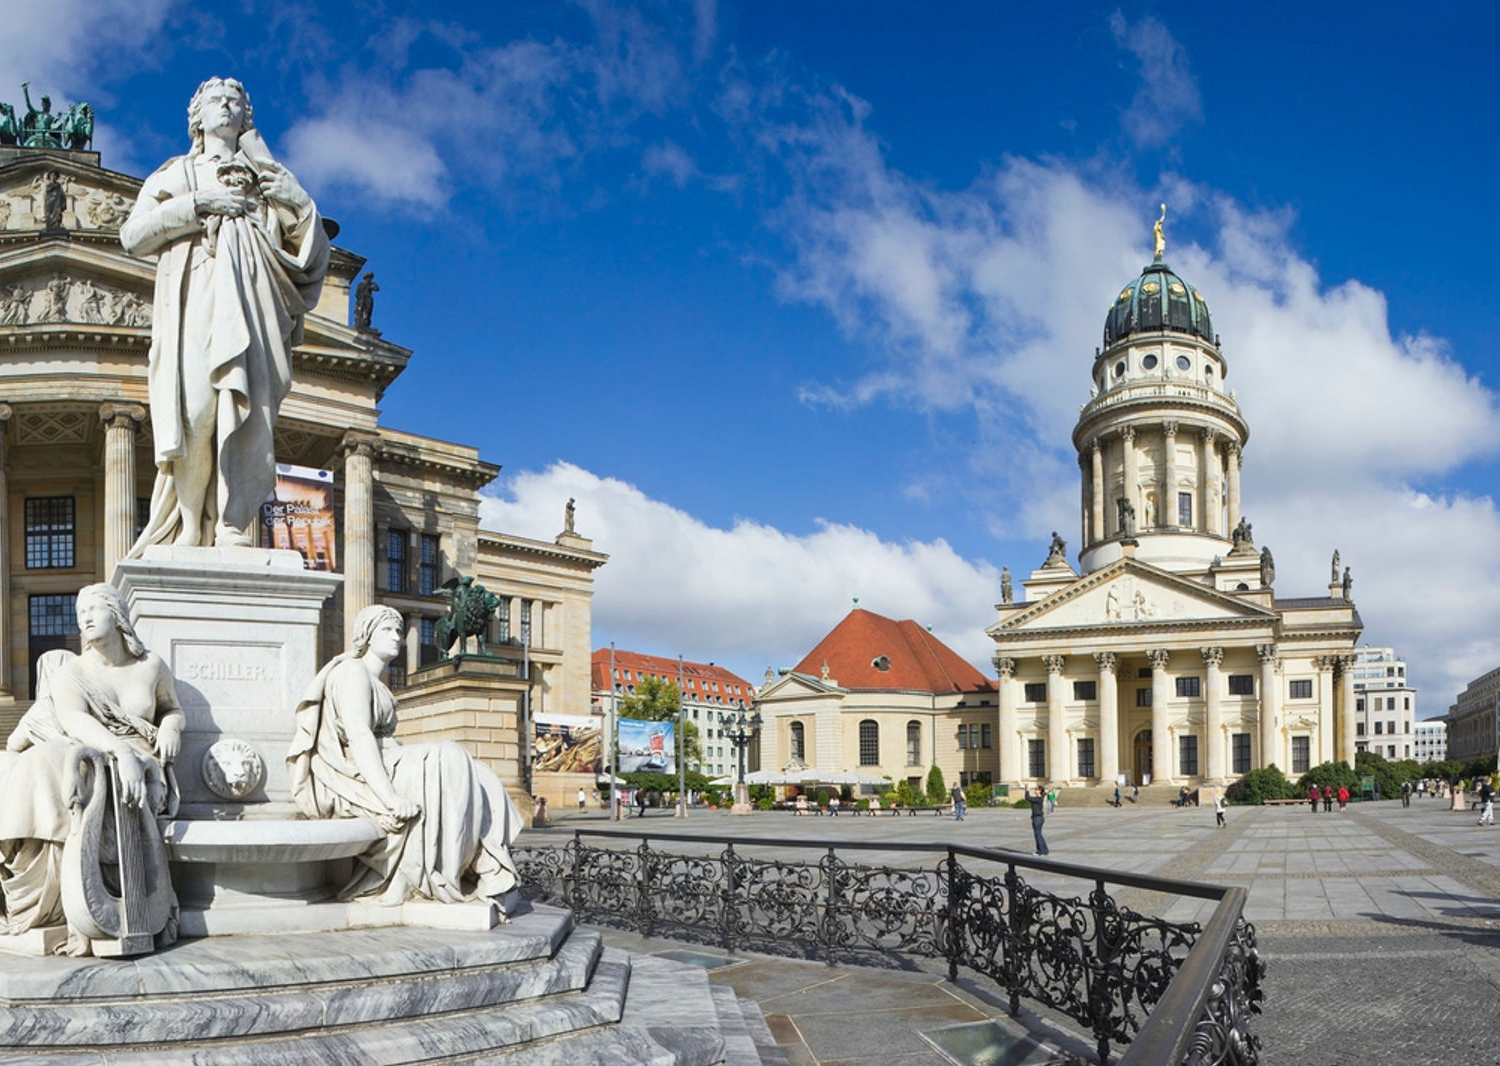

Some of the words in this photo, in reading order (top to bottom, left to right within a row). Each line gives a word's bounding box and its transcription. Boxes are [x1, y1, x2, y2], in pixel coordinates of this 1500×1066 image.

[264, 503, 285, 514] Der
[286, 503, 319, 515] Palast
[265, 516, 285, 525] der
[286, 516, 333, 527] Republik
